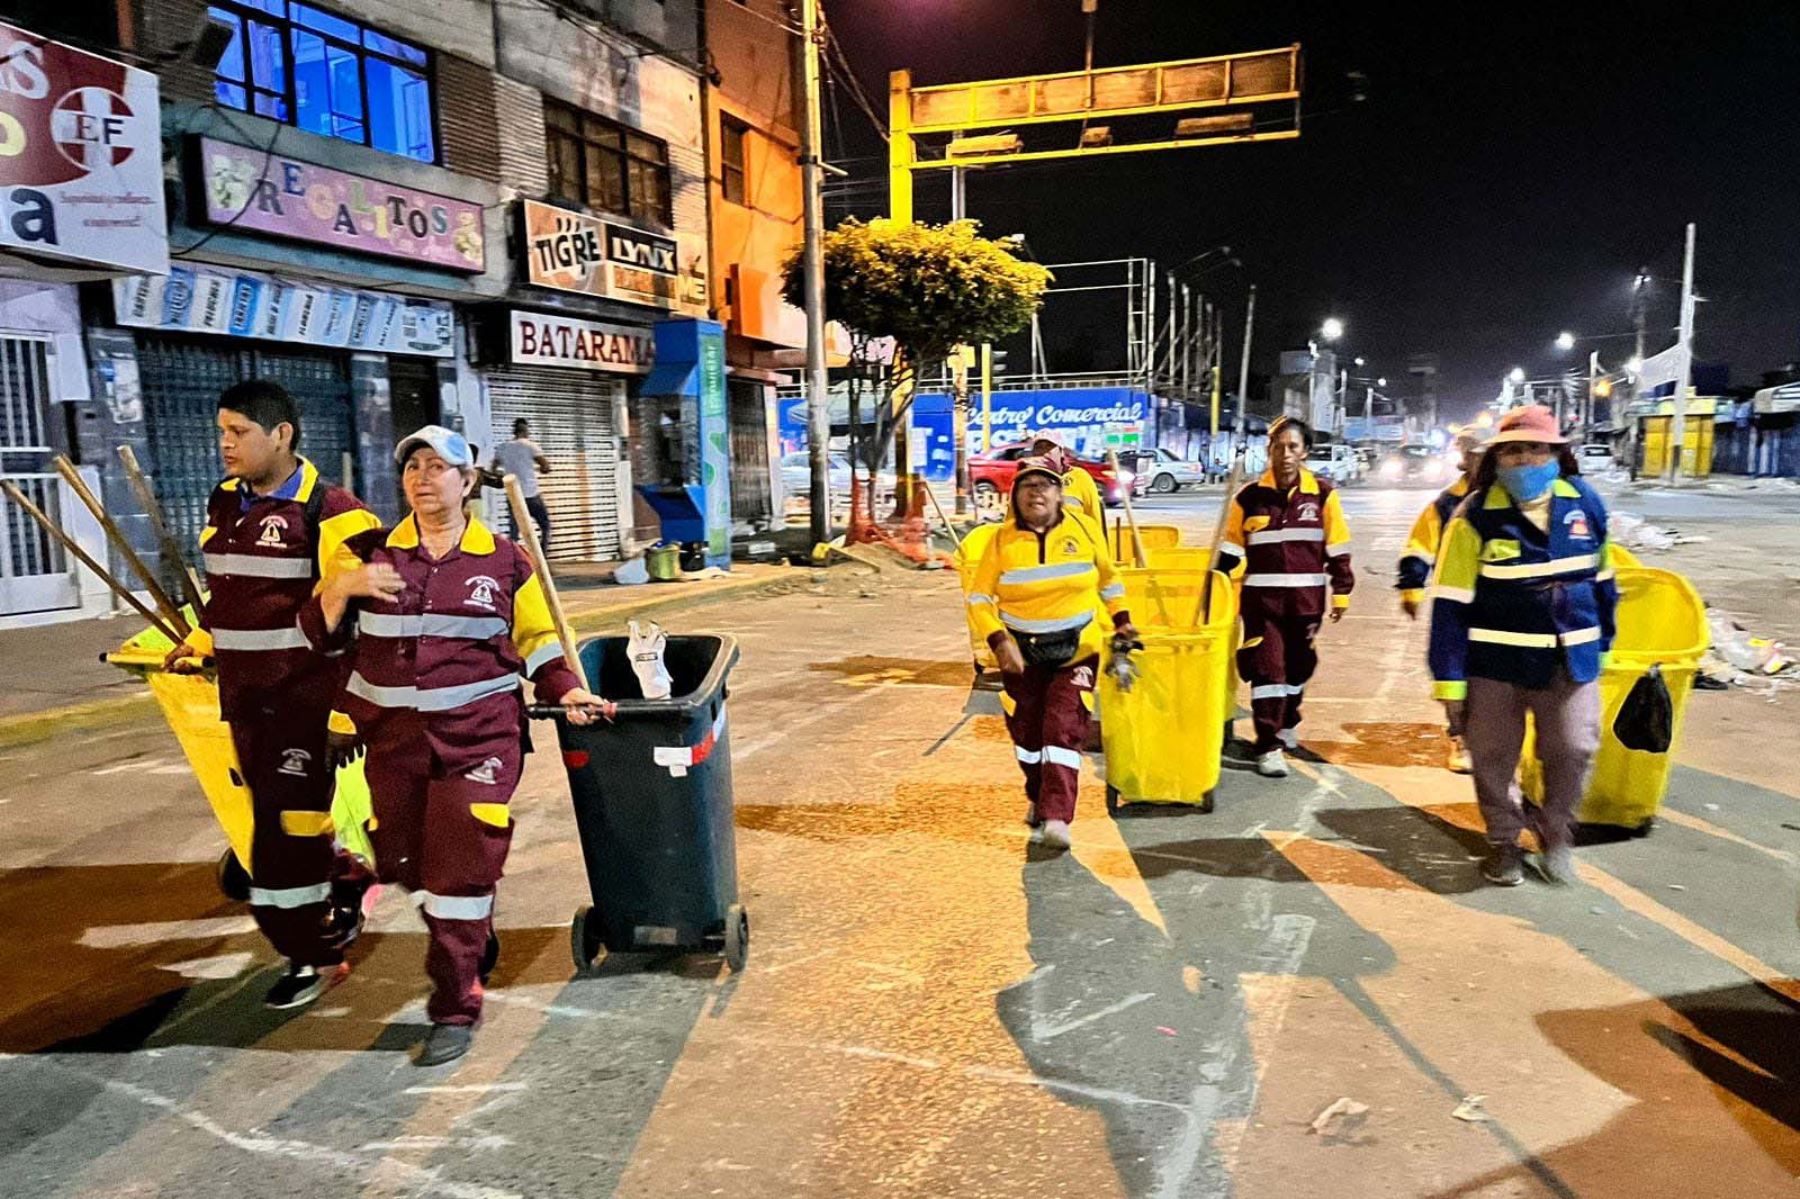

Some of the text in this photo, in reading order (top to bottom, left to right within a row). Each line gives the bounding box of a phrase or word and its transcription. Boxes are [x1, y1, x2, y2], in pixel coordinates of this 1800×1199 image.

[255, 161, 448, 239] REGALITOS
[535, 231, 602, 271] TIGRE
[612, 236, 676, 272] LYNX
[1036, 402, 1142, 425] Comercial
